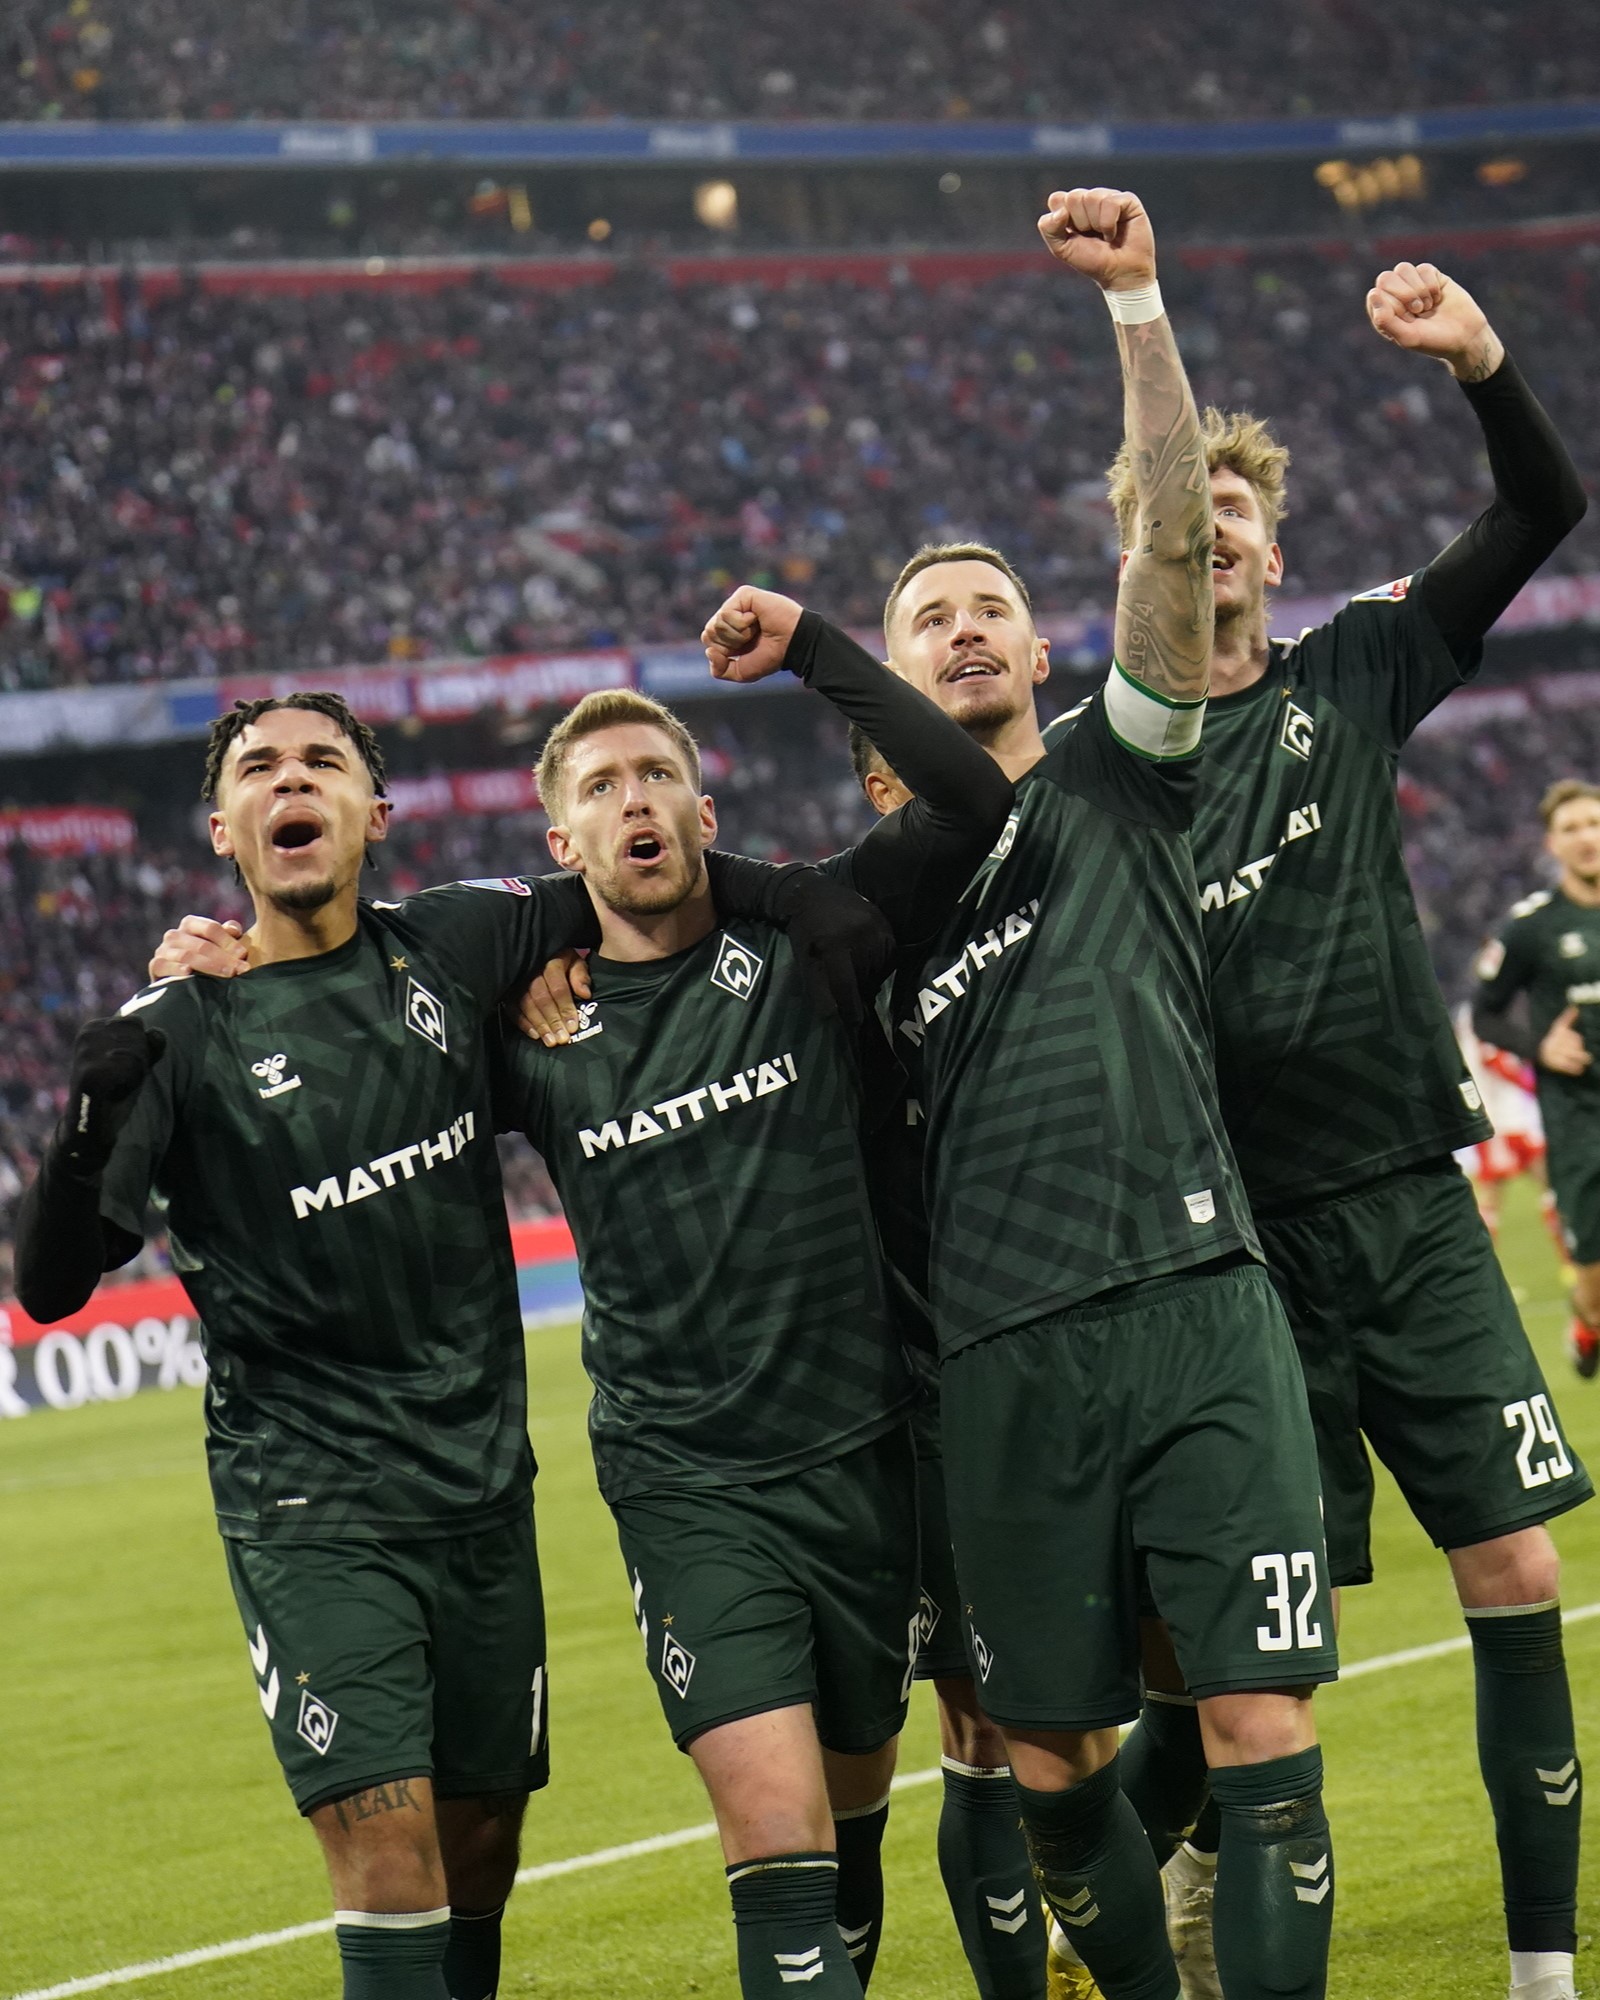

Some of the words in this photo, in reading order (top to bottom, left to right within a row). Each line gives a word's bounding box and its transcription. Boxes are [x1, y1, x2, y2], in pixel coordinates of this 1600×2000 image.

[578, 1053, 798, 1159] MATTHÄI
[290, 1111, 475, 1219] MATTHÄI
[1503, 1393, 1573, 1490] 29
[1251, 1551, 1323, 1652] 32
